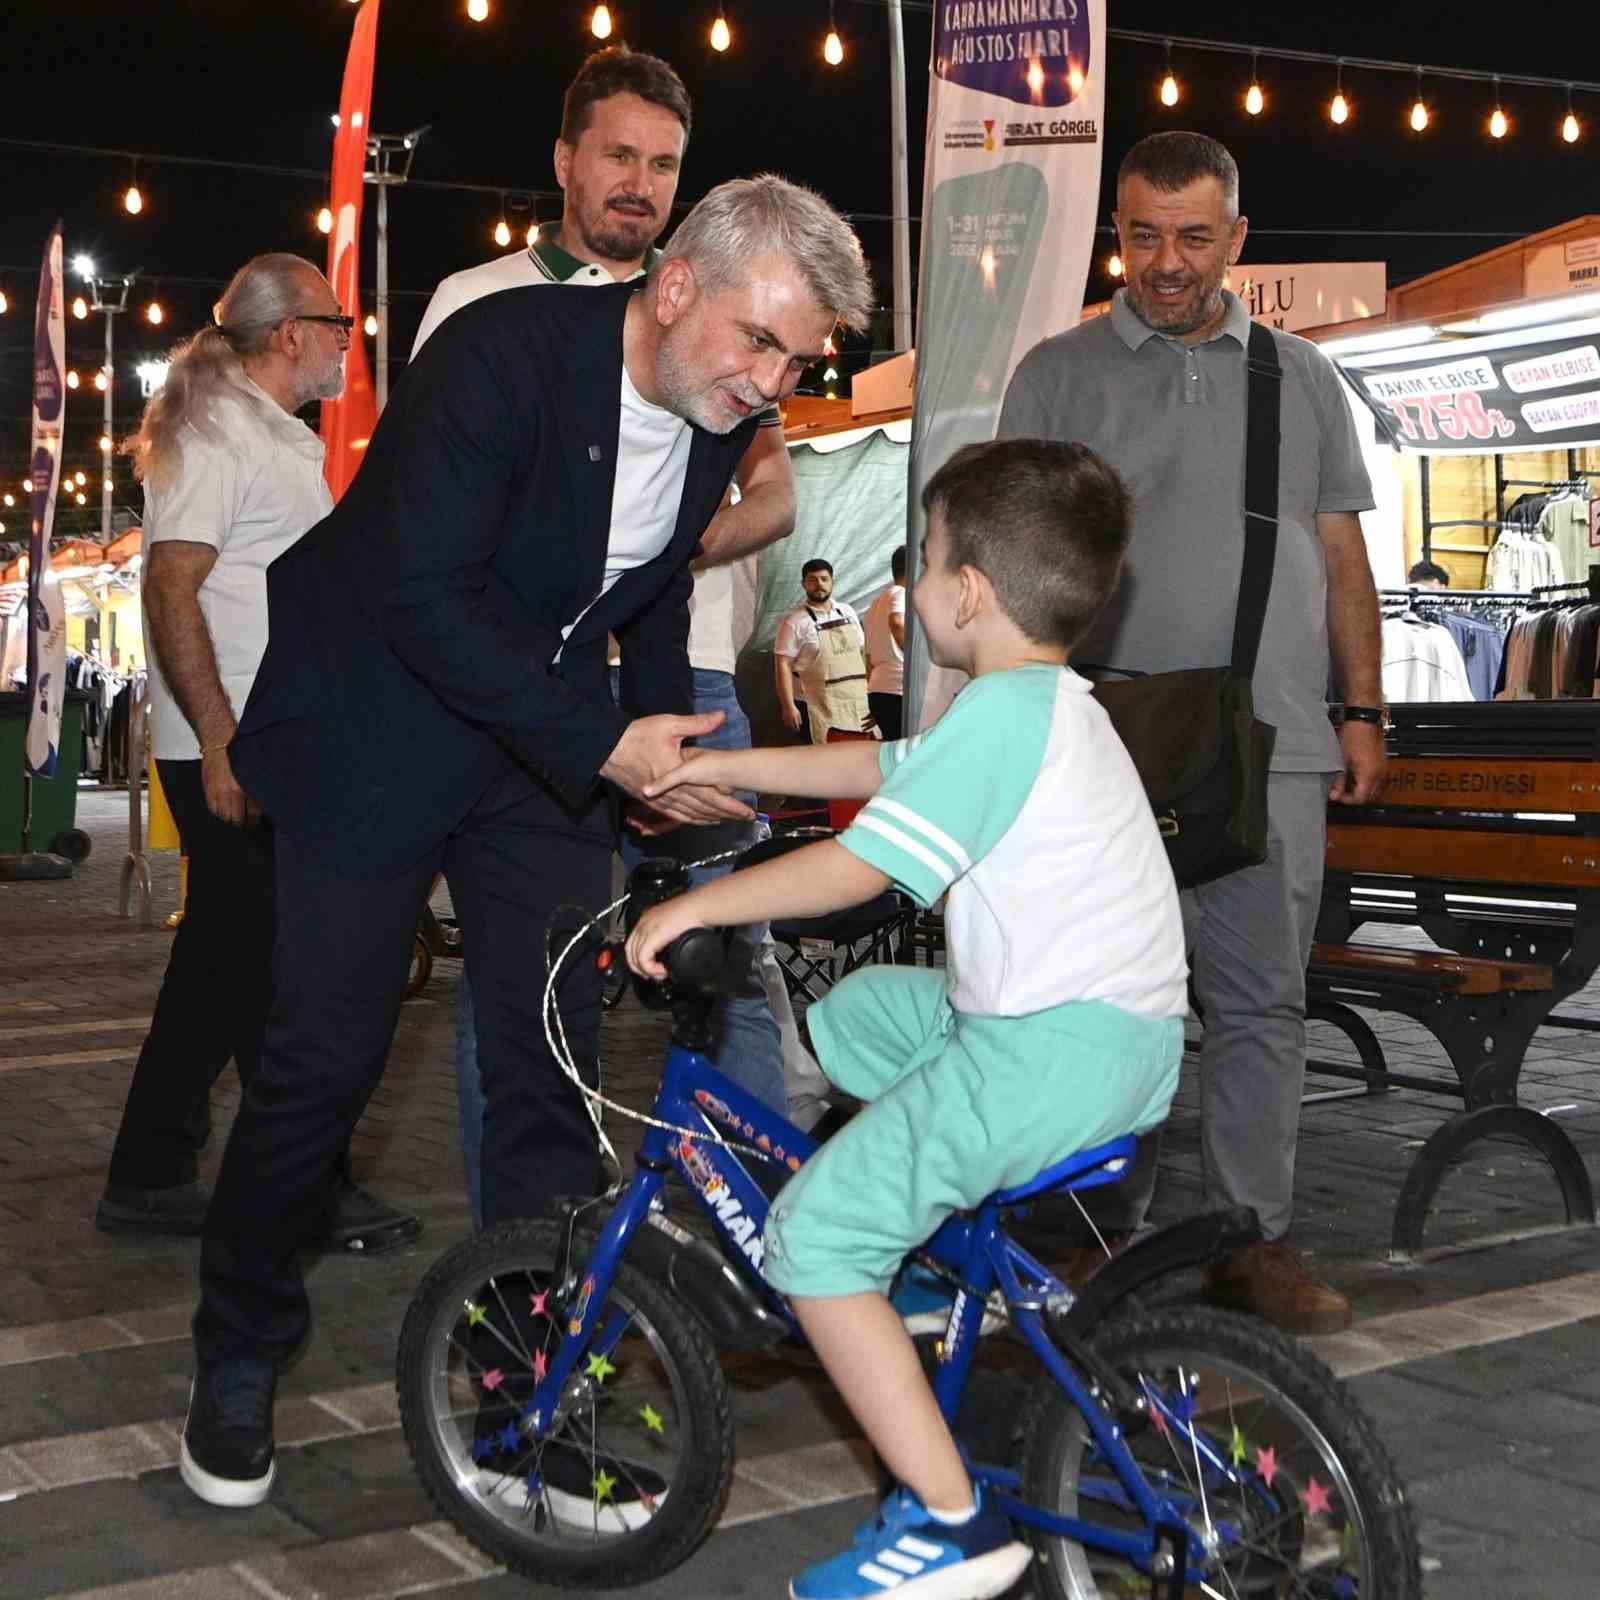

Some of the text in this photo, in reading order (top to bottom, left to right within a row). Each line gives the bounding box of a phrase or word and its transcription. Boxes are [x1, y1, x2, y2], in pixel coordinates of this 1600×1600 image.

[951, 32, 1016, 66] AĞUSTOS
[1050, 119, 1098, 136] GÖRGEL
[1374, 378, 1426, 398] TAKIM
